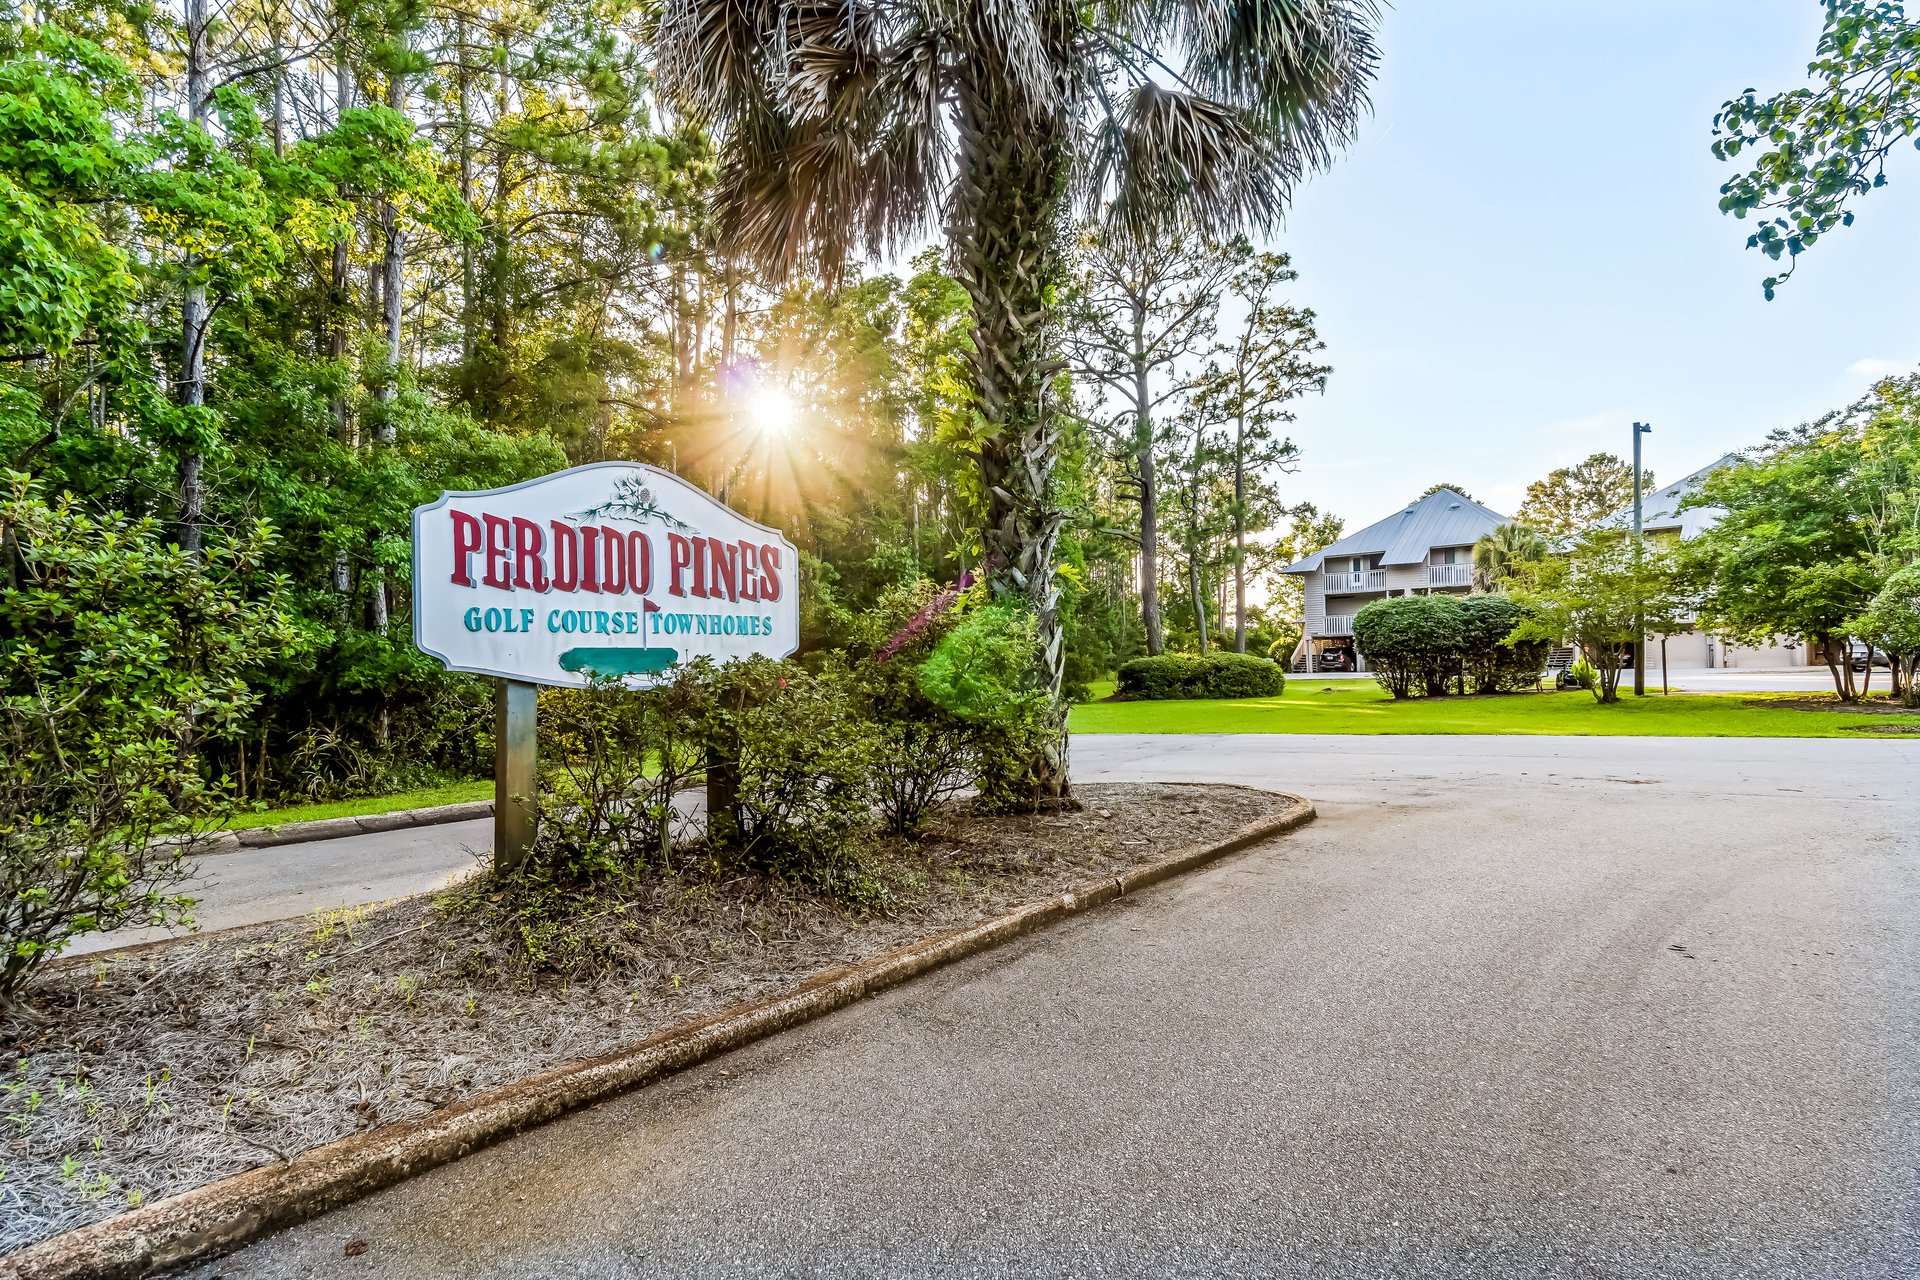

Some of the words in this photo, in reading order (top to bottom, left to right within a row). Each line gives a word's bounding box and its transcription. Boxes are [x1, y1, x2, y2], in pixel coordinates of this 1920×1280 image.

[450, 509, 652, 595] PERDIDO
[667, 531, 783, 603] PINES
[464, 606, 535, 633] GOLF
[547, 608, 639, 636] COURSE
[650, 612, 773, 636] TOWNHOMES
